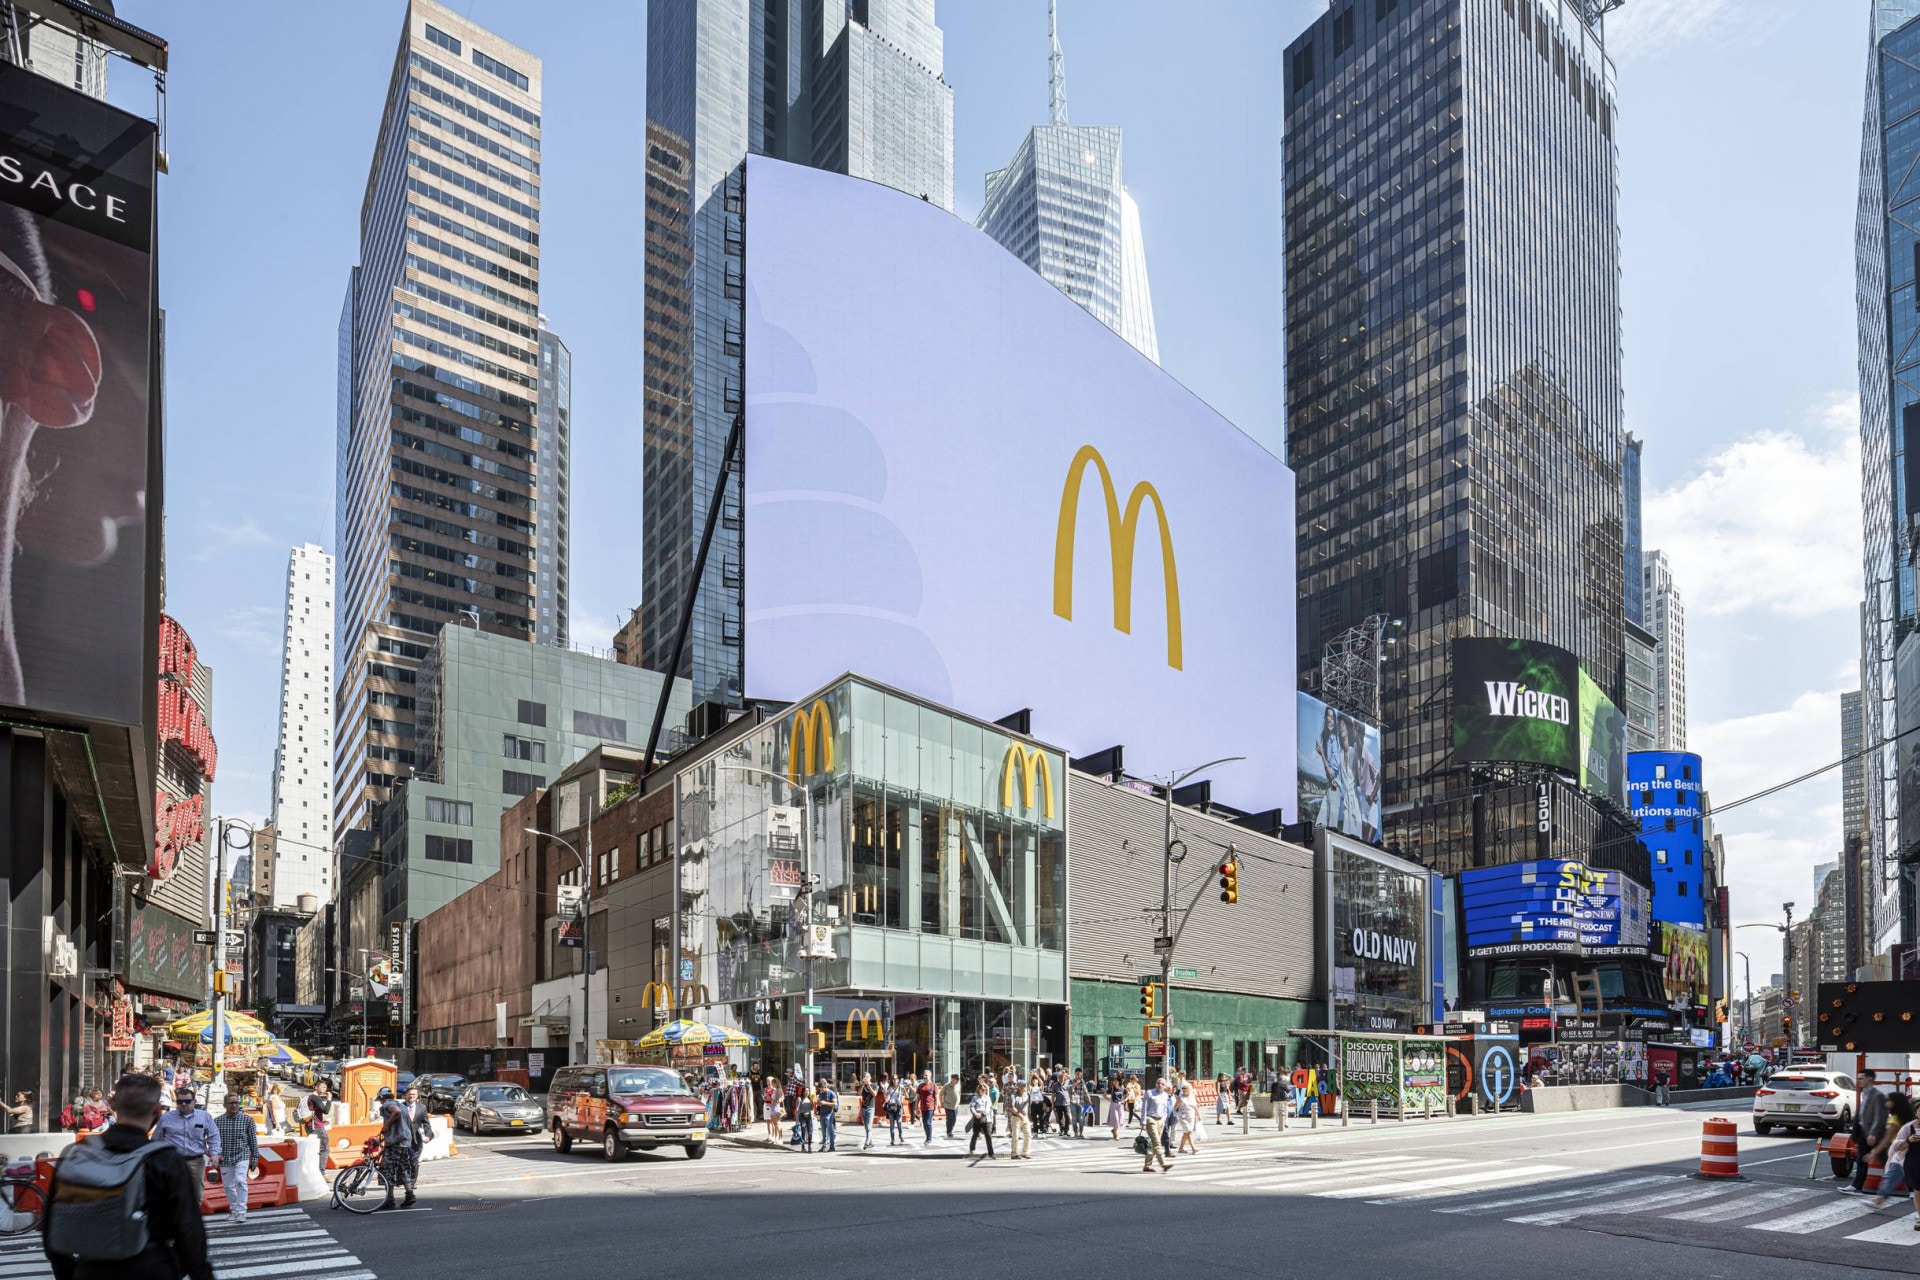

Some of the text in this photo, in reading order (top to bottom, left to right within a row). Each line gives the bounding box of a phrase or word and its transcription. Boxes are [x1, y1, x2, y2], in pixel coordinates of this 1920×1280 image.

[0, 156, 126, 224] SACE
[1651, 779, 1672, 789] the
[1674, 779, 1694, 790] Best
[1538, 784, 1549, 832] 1500
[1673, 807, 1692, 816] and
[771, 861, 799, 873] ALL
[769, 871, 800, 884] RISE
[1592, 911, 1615, 919] NEWS
[1538, 918, 1559, 926] THE
[1580, 922, 1613, 932] PODCAST
[392, 927, 400, 973] STARBUC
[1353, 928, 1417, 967] OLD NAVY
[1477, 946, 1494, 956] GET
[1494, 944, 1520, 954] YOUR
[1593, 947, 1620, 955] HERE
[1174, 968, 1196, 978] Broadway
[1490, 1007, 1525, 1016] Supreme
[1370, 1017, 1397, 1029] OLD NAVY
[1346, 1043, 1393, 1052] DISCOVER
[1346, 1051, 1393, 1074] BROADWAY'S
[1346, 1072, 1393, 1083] SECRETS
